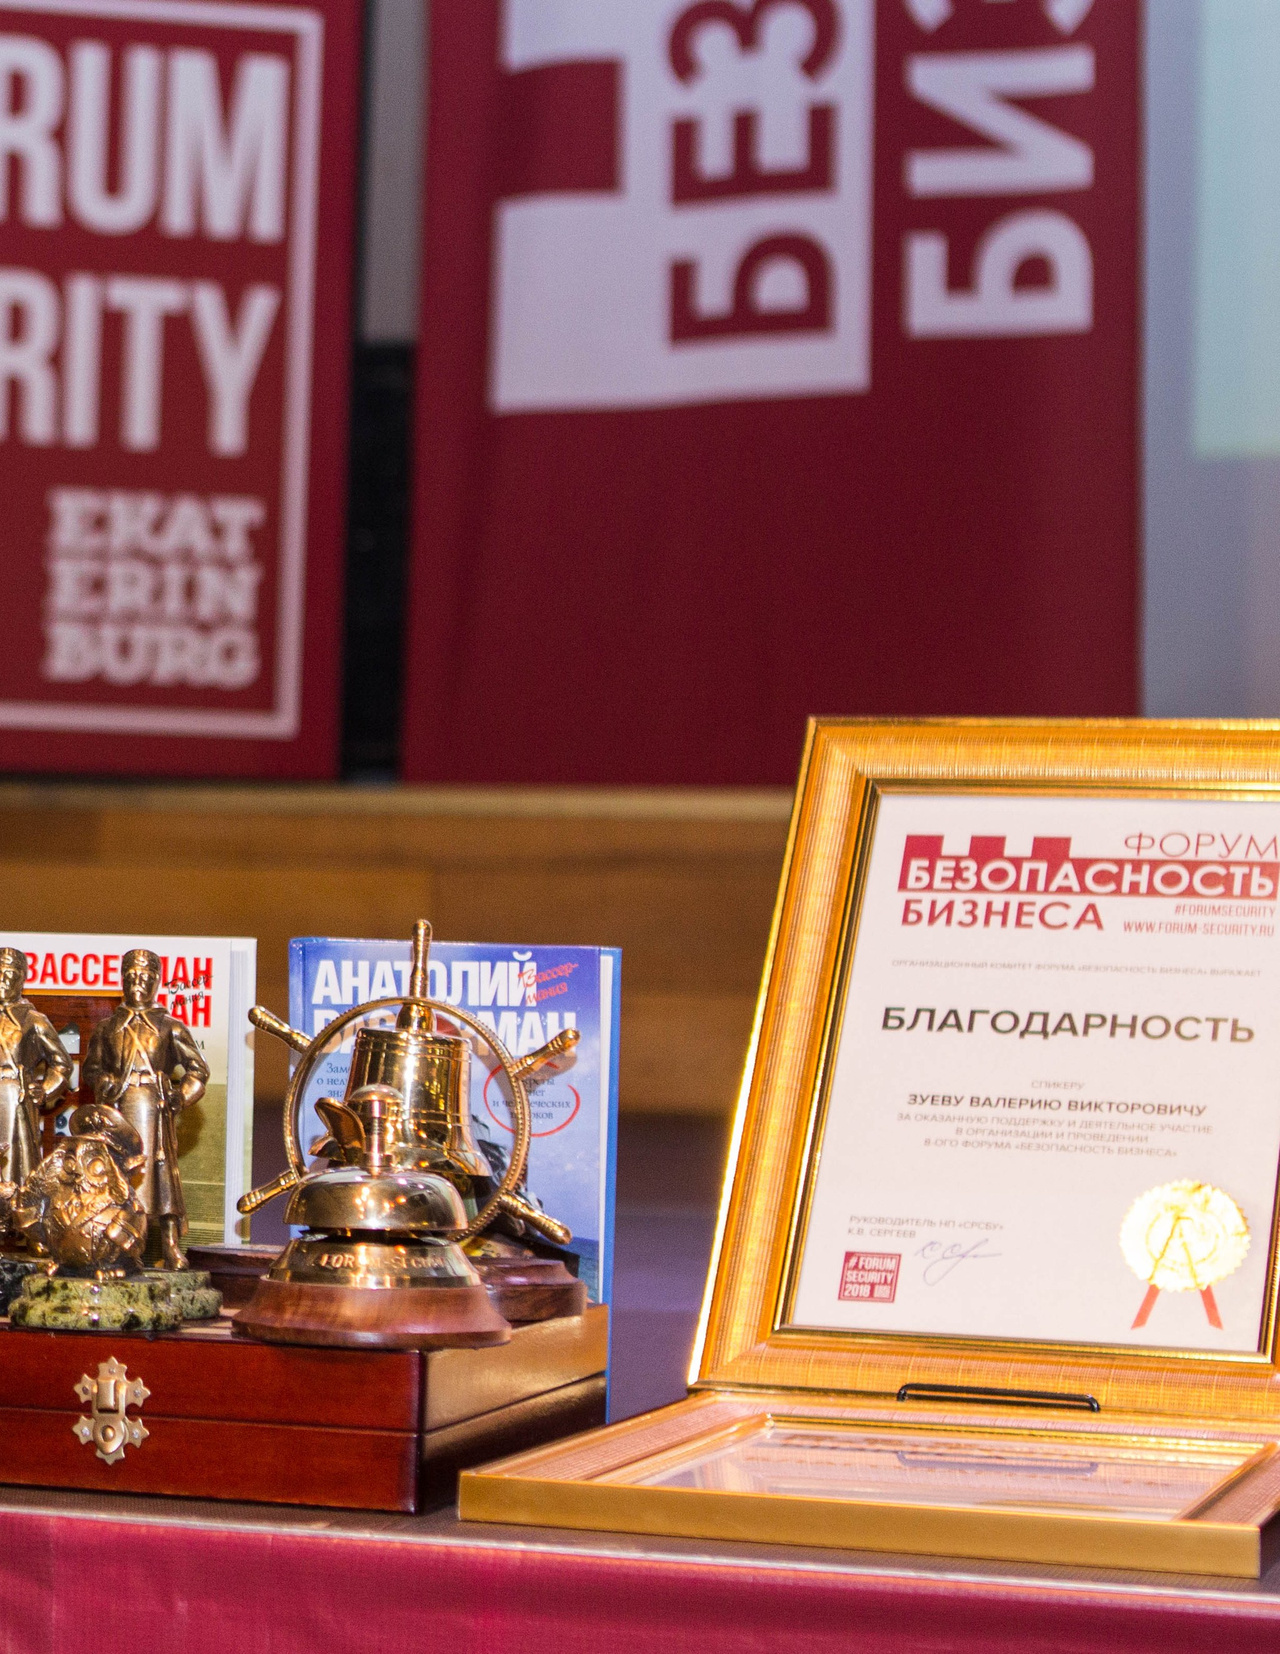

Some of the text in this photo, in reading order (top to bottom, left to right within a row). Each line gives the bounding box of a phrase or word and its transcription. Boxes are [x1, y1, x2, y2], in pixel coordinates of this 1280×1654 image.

[47, 485, 267, 558] EKAT
[46, 557, 264, 620] ERIN
[43, 620, 262, 690] BURG
[1124, 832, 1278, 859] ФОРУМ
[907, 859, 1275, 897] БЕЗОПАСНОСТЬ
[901, 898, 1105, 931] БИЗНЕСА
[1175, 904, 1277, 918] #FORUMSECURITY
[1123, 921, 1276, 937] WWW.FORUM-SECURITY.RU
[881, 1006, 1255, 1043] БЛАГОДАРНОСТЬ
[1031, 1080, 1085, 1091] СПИКЕРУ
[907, 1093, 1207, 1117] ЗУЕВУ ВАЛЕРИЮ ВИКТОРОВИЧУ
[897, 1112, 1214, 1135] ЗА ОКАЗАННУЮ ПОДДЕРЖКУ И ДЕЯТЕЛЬНОЕ УЧАСТИЕ
[955, 1127, 1149, 1144] В ОРГАНИЗАЦИИ И ПРОВЕДЕНИИ
[961, 1139, 1012, 1150] ФОРУМА
[849, 1215, 936, 1227] РУКОВОДИТЕЛЬ
[939, 1220, 955, 1229] НП
[869, 1229, 916, 1239] СЕРГЕЕВ
[859, 1256, 896, 1271] FORUM
[846, 1270, 895, 1284] SECURITY
[844, 1284, 870, 1297] 2018
